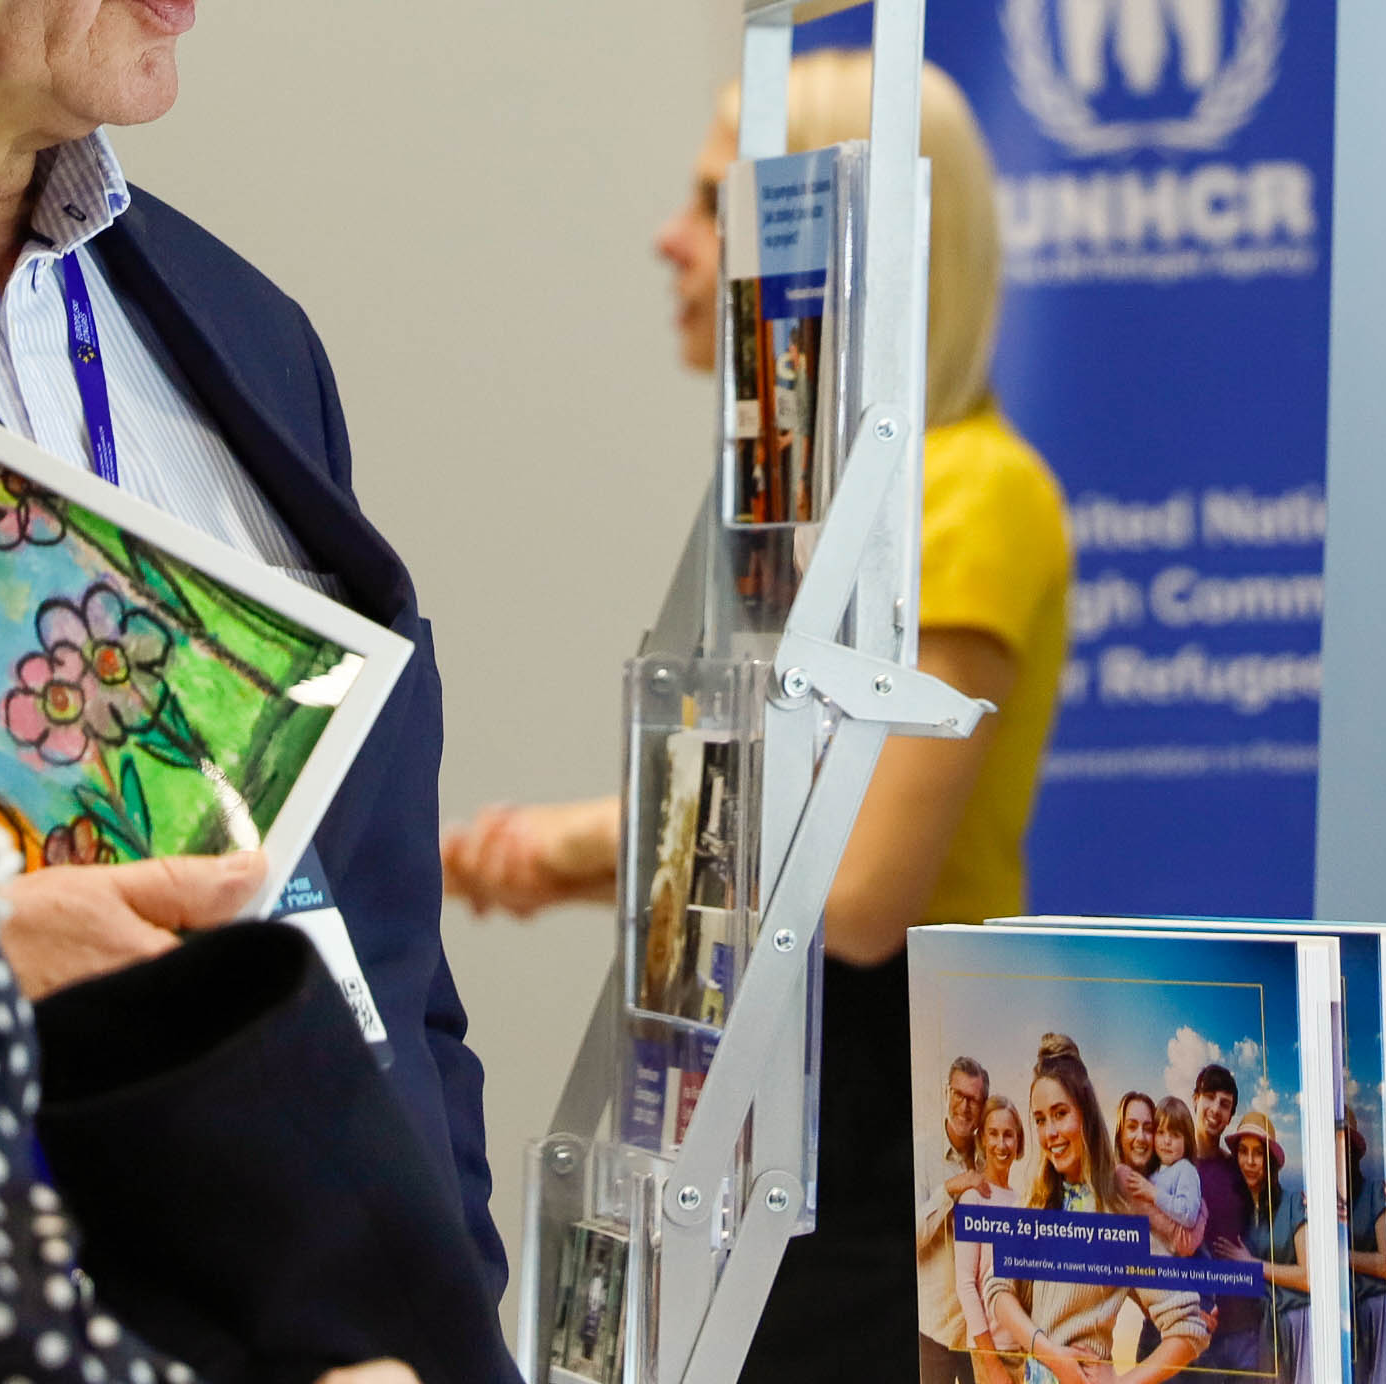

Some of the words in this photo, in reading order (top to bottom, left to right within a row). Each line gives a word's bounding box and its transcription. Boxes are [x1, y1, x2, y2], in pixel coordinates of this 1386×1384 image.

[996, 161, 1314, 246] UNHCR
[1201, 485, 1326, 547] Nati
[1068, 570, 1144, 642] gh
[1150, 564, 1324, 629] Comm
[964, 1216, 1014, 1236] Dobrze,
[1017, 1218, 1032, 1235] że
[1033, 1220, 1094, 1244] jesteśmy
[1097, 1226, 1140, 1243] razem
[1004, 1256, 1013, 1266] 20
[1014, 1257, 1055, 1270] bohaterów,
[1063, 1262, 1086, 1272] nawet
[1114, 1266, 1124, 1274] na
[1157, 1267, 1180, 1278] Polski
[1181, 1270, 1188, 1278] w
[1189, 1269, 1205, 1280] Unii
[1206, 1271, 1253, 1286] Europejskiej
